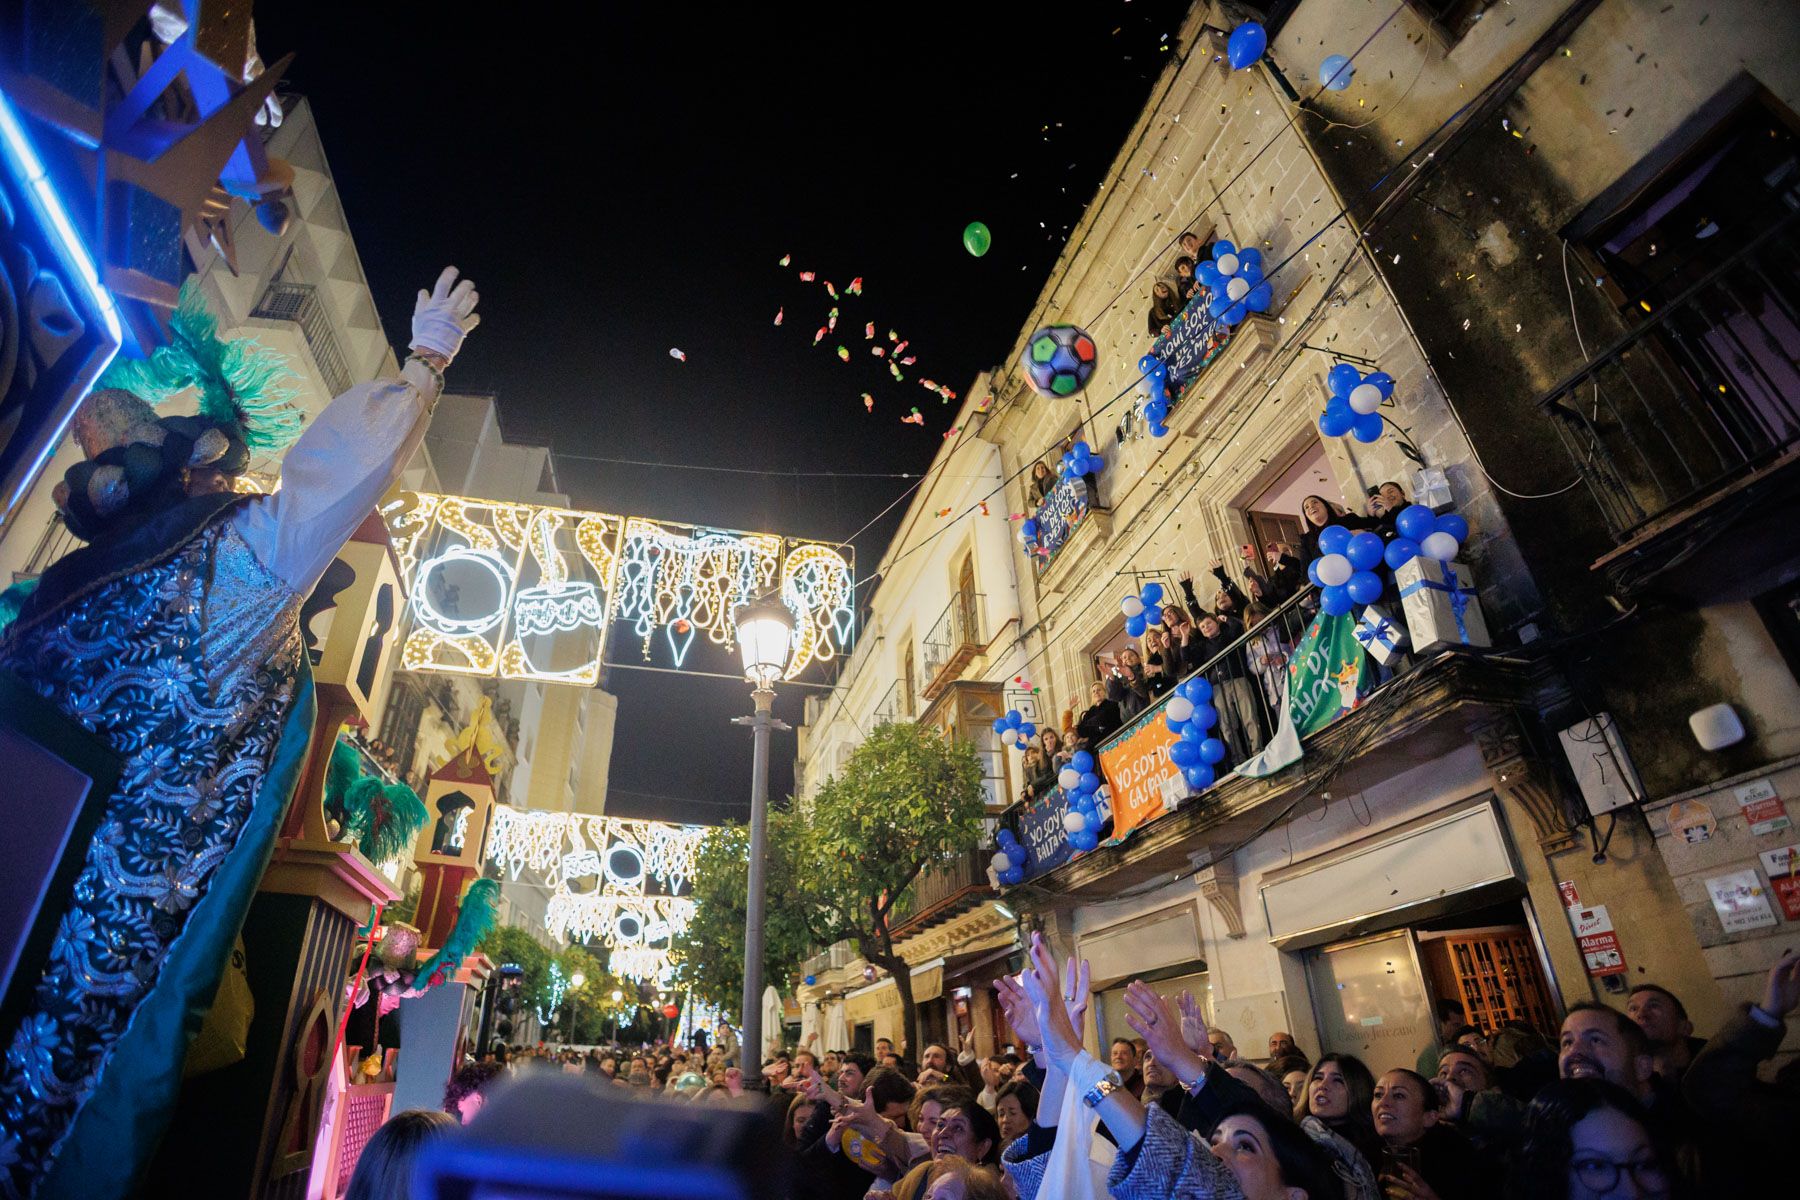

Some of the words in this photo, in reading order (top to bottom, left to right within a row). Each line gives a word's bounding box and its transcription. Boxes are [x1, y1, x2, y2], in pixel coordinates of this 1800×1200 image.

[1160, 326, 1184, 360] AQUÍ
[1185, 292, 1213, 337] SOMO
[1115, 767, 1132, 793] YO
[1133, 750, 1155, 783] SOY
[1029, 825, 1043, 846] YO
[1044, 811, 1060, 838] SOY
[1581, 935, 1614, 948] Alarma
[1371, 1024, 1416, 1040] Jerezano
